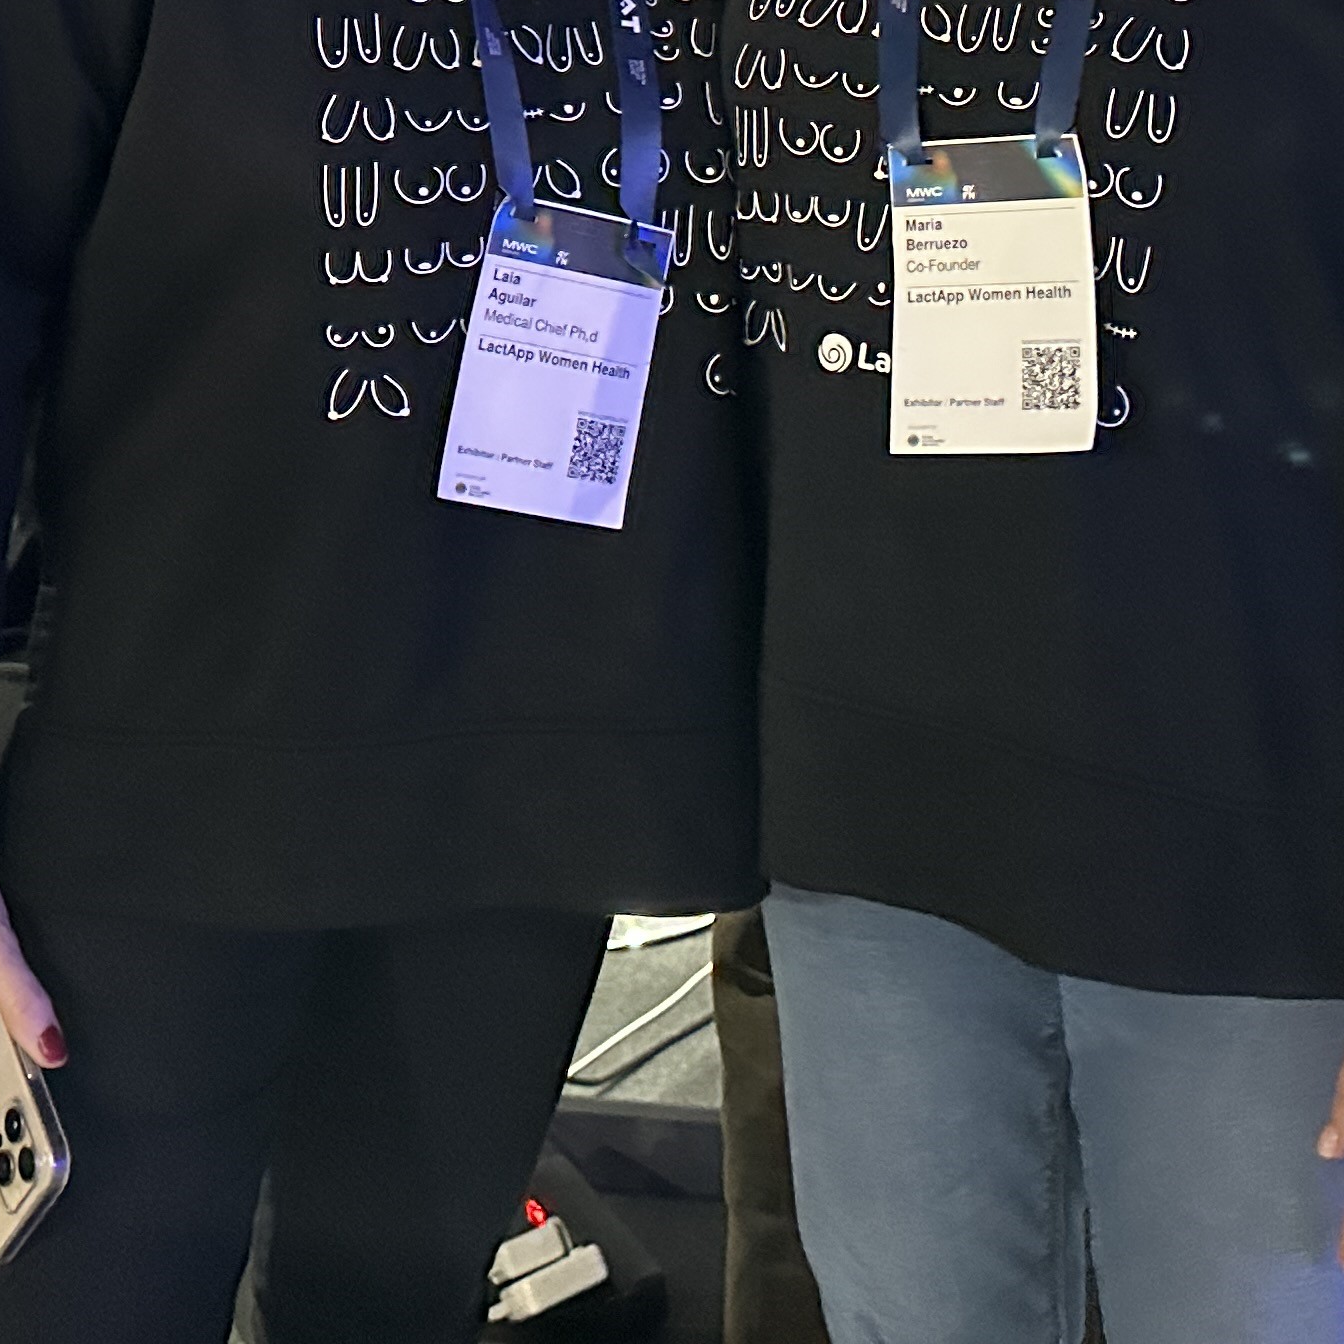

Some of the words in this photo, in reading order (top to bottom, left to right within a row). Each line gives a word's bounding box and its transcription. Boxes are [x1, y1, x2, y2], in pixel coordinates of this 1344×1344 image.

[906, 186, 944, 198] MWC
[502, 238, 539, 255] MWC
[906, 238, 968, 252] Berruezo
[906, 258, 981, 273] Co-Founder
[488, 287, 537, 307] Aguilar
[907, 289, 964, 306] LactApp
[968, 286, 1021, 302] Women
[1025, 285, 1072, 300] Health
[483, 308, 533, 330] Medical
[535, 318, 568, 337] Chief
[478, 338, 534, 362] LactApp
[539, 349, 588, 371] Women
[592, 360, 630, 380] Health
